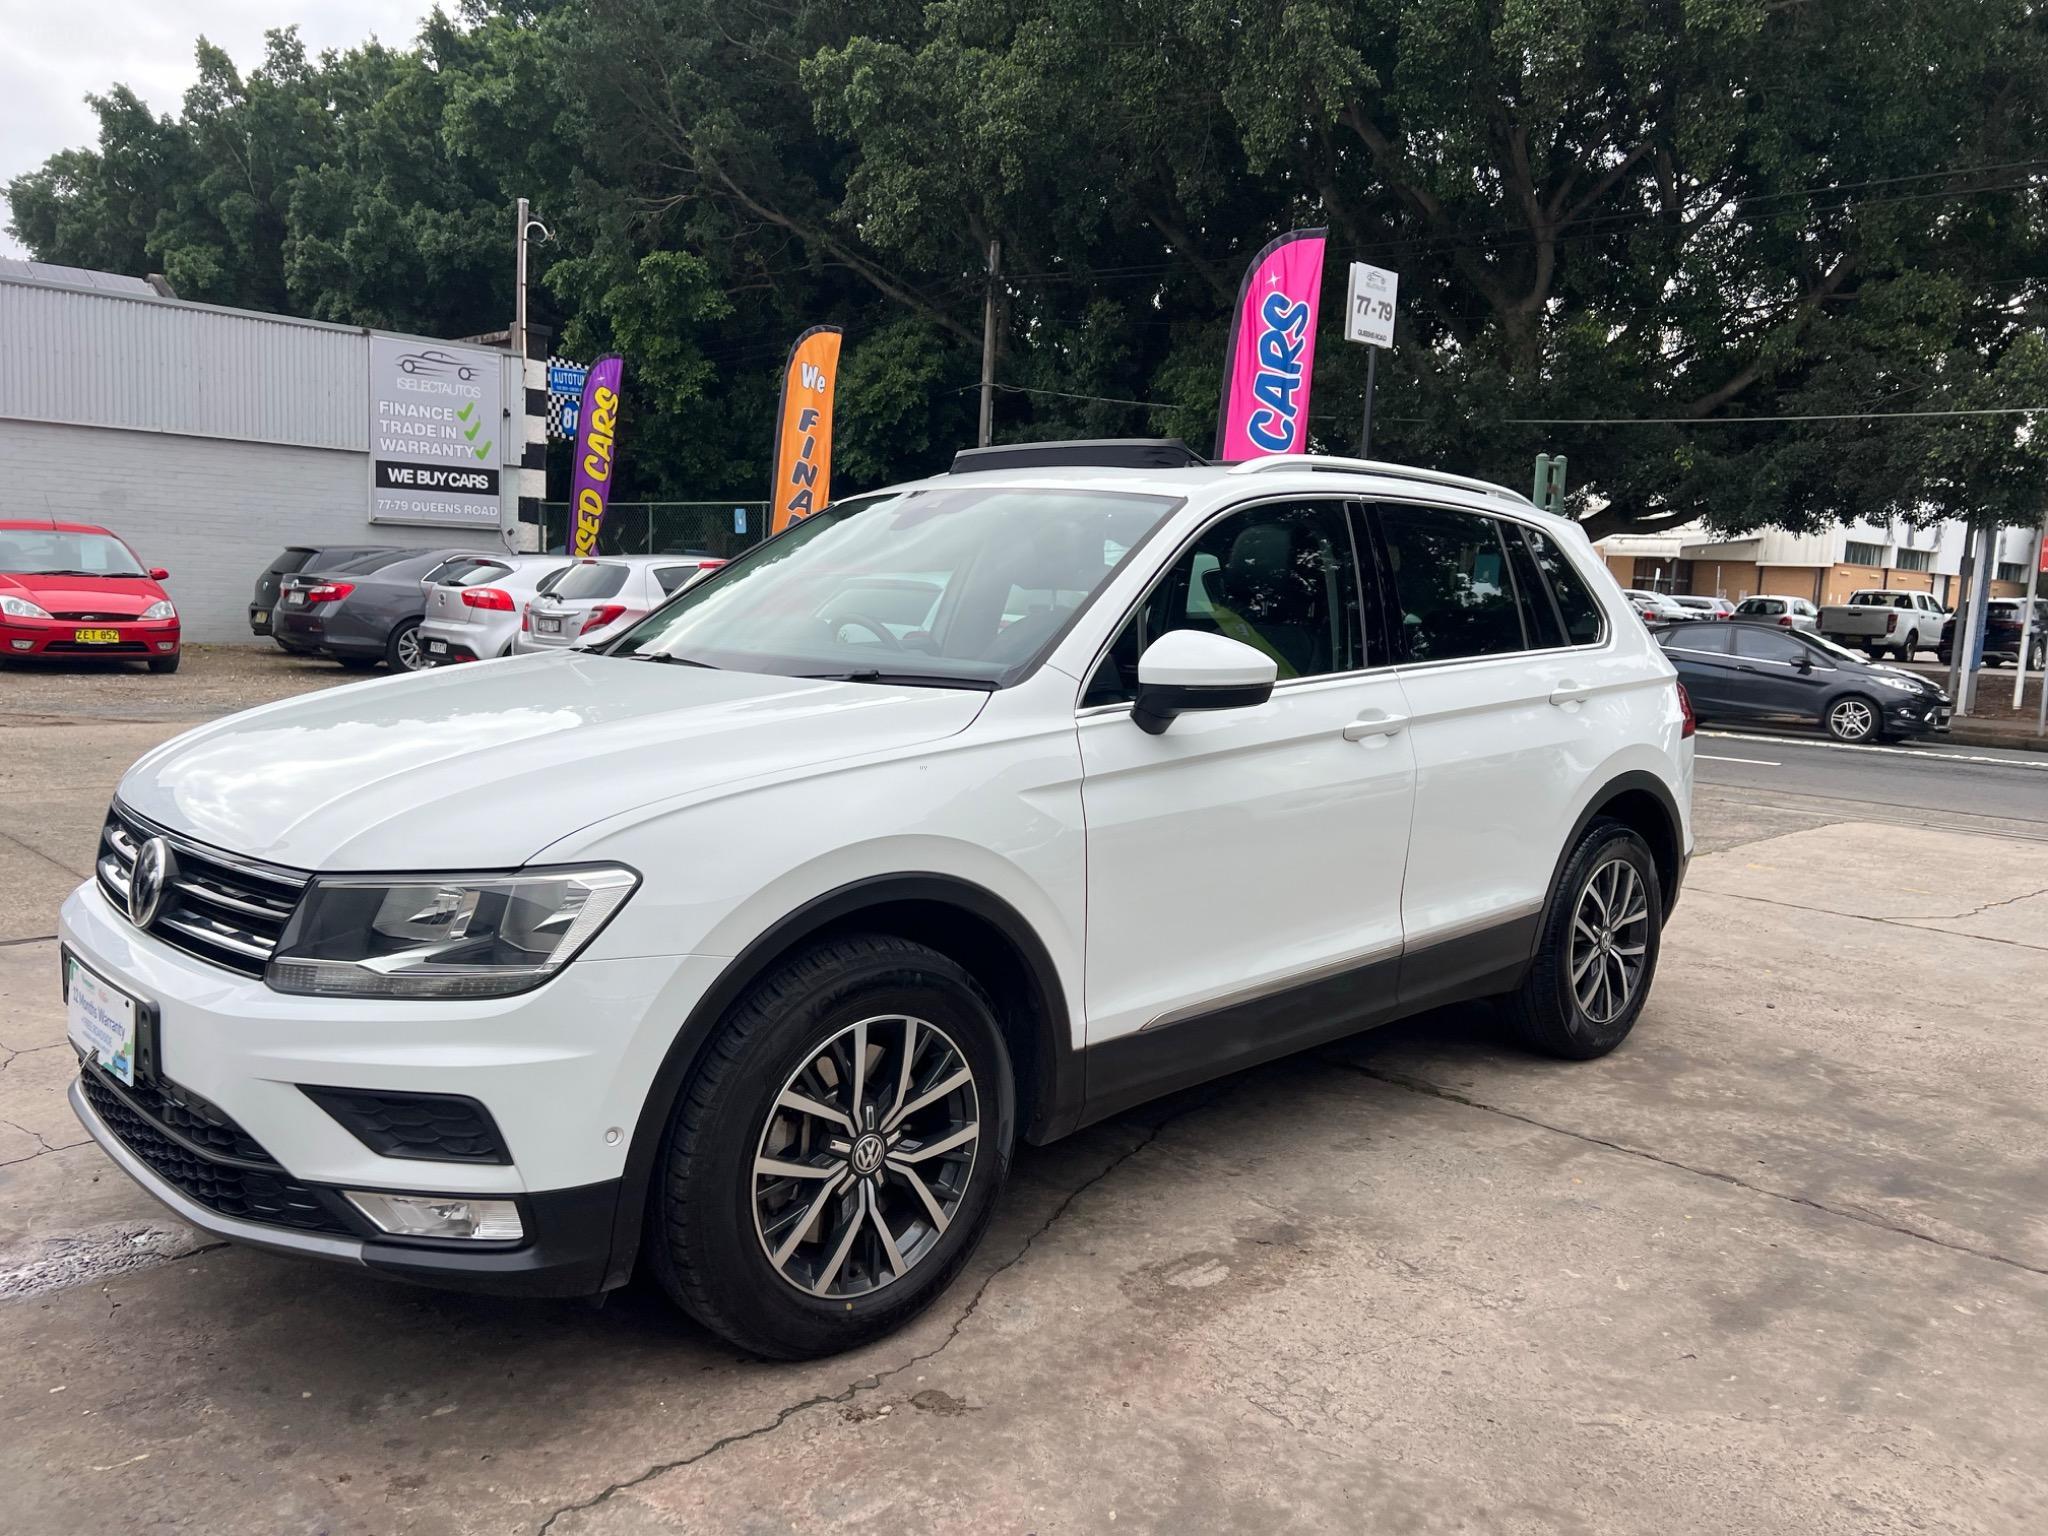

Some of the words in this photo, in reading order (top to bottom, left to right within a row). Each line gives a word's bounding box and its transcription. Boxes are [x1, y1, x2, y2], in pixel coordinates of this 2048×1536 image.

[1356, 295, 1393, 321] 77-79
[801, 362, 826, 393] We
[1247, 292, 1310, 453] CARS
[379, 401, 453, 421] FINANCE
[379, 419, 437, 437] TRADE
[440, 425, 457, 439] IN
[583, 386, 619, 483] CARS
[379, 437, 475, 458] WARRANTY
[387, 467, 414, 484] WE
[416, 470, 448, 486] BUY
[447, 472, 489, 489] CARS
[378, 499, 408, 511] 77-79
[411, 501, 461, 514] QUEENS
[463, 505, 498, 516] ROAD
